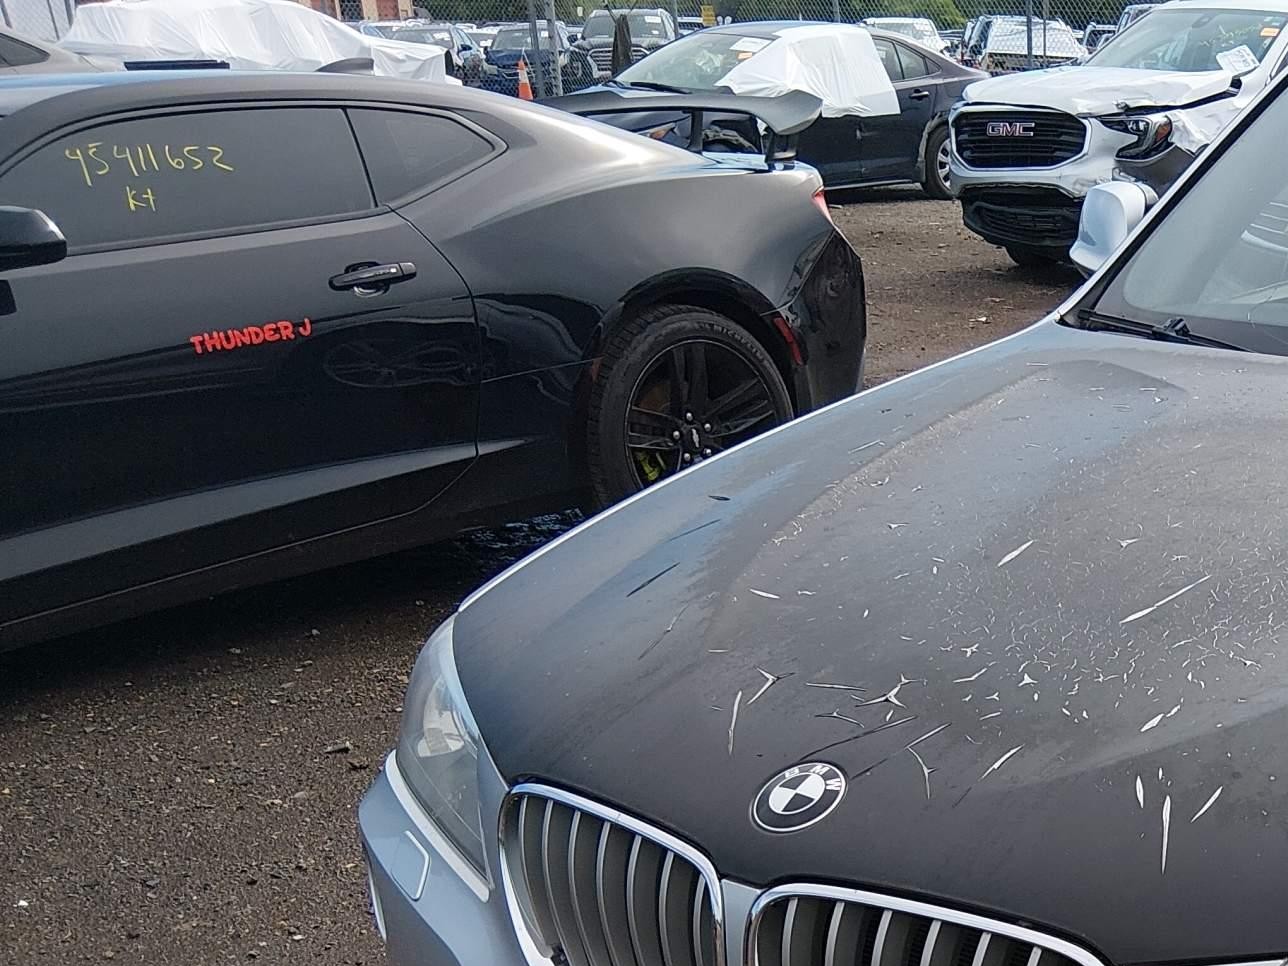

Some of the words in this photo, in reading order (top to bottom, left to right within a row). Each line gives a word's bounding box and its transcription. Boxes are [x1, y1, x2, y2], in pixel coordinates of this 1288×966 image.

[986, 122, 1036, 137] GMC
[64, 141, 234, 187] 45411652
[191, 321, 294, 354] THUNDER
[299, 318, 312, 337] J
